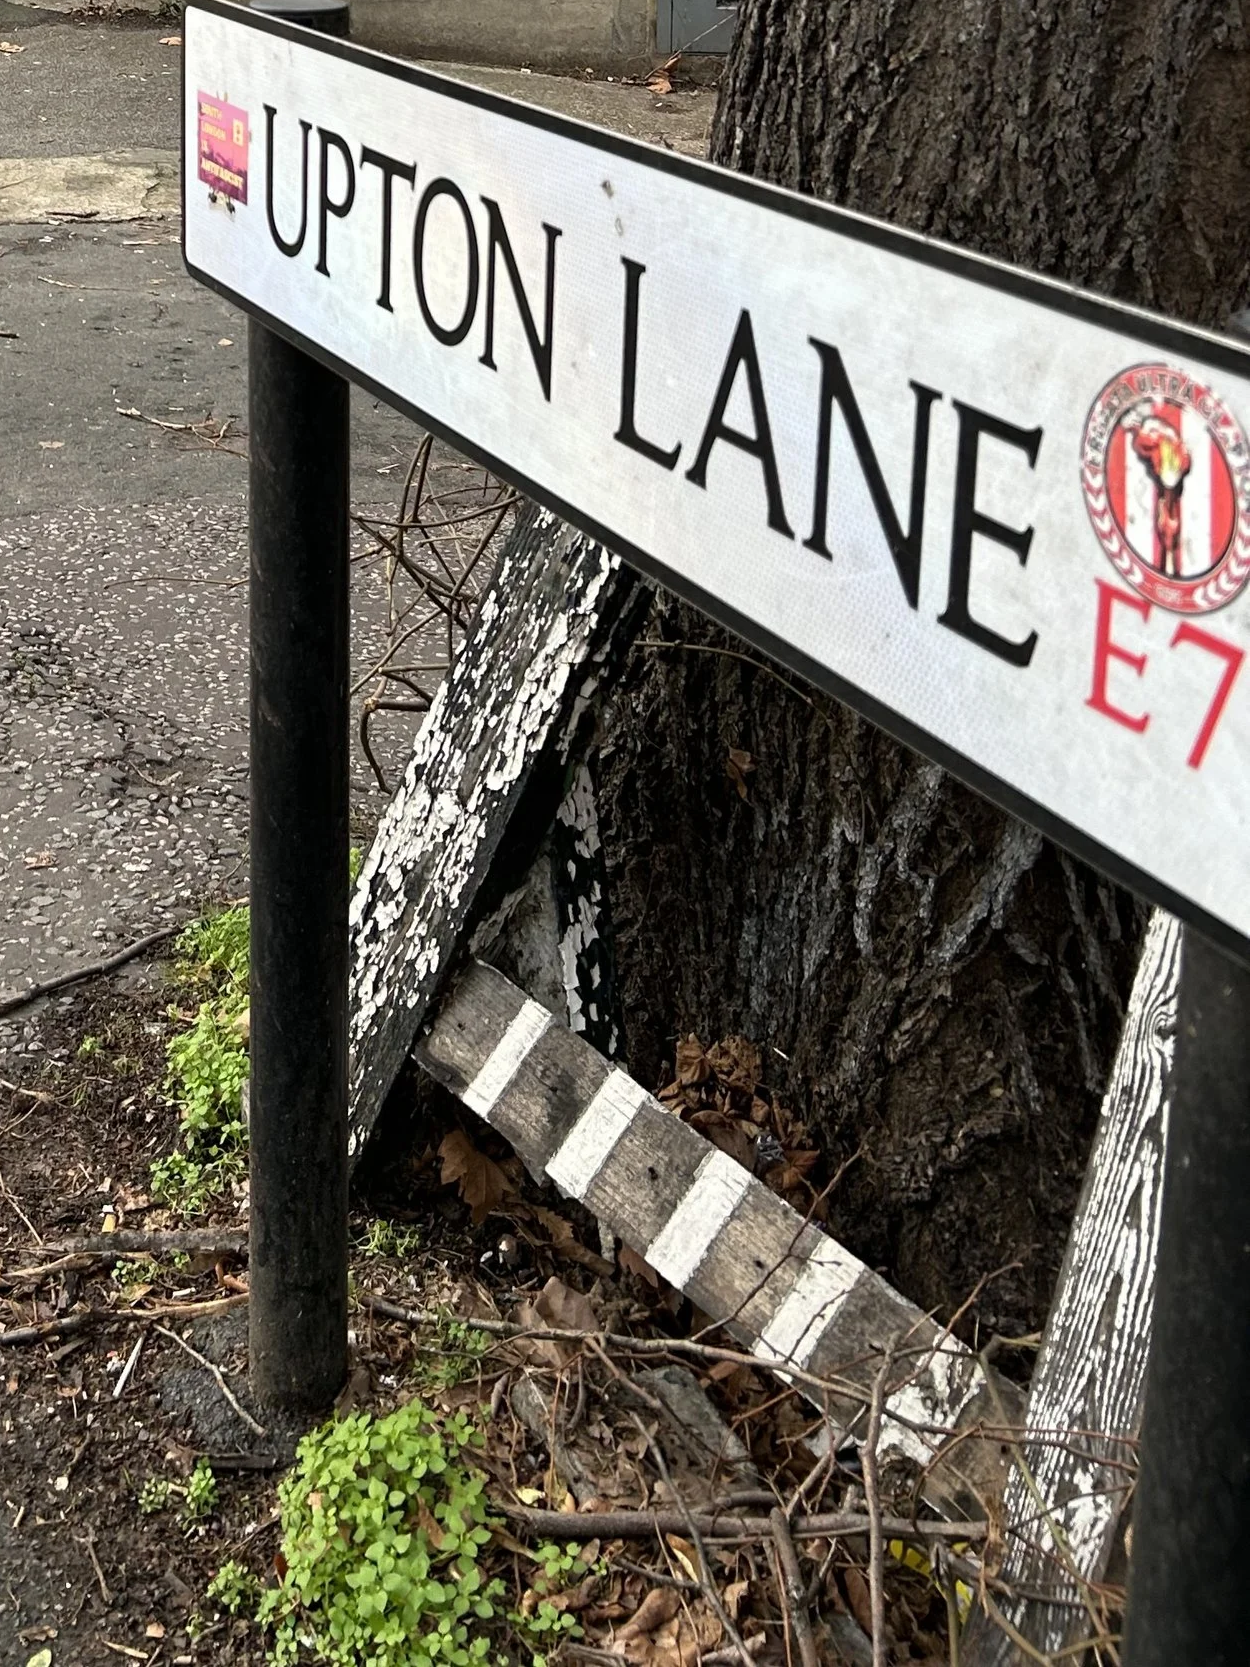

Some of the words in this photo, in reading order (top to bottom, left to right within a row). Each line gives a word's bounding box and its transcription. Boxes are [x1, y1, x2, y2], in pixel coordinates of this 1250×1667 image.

[262, 103, 562, 402] UPTON
[614, 256, 1043, 668] LANE
[1084, 577, 1246, 771] E7
